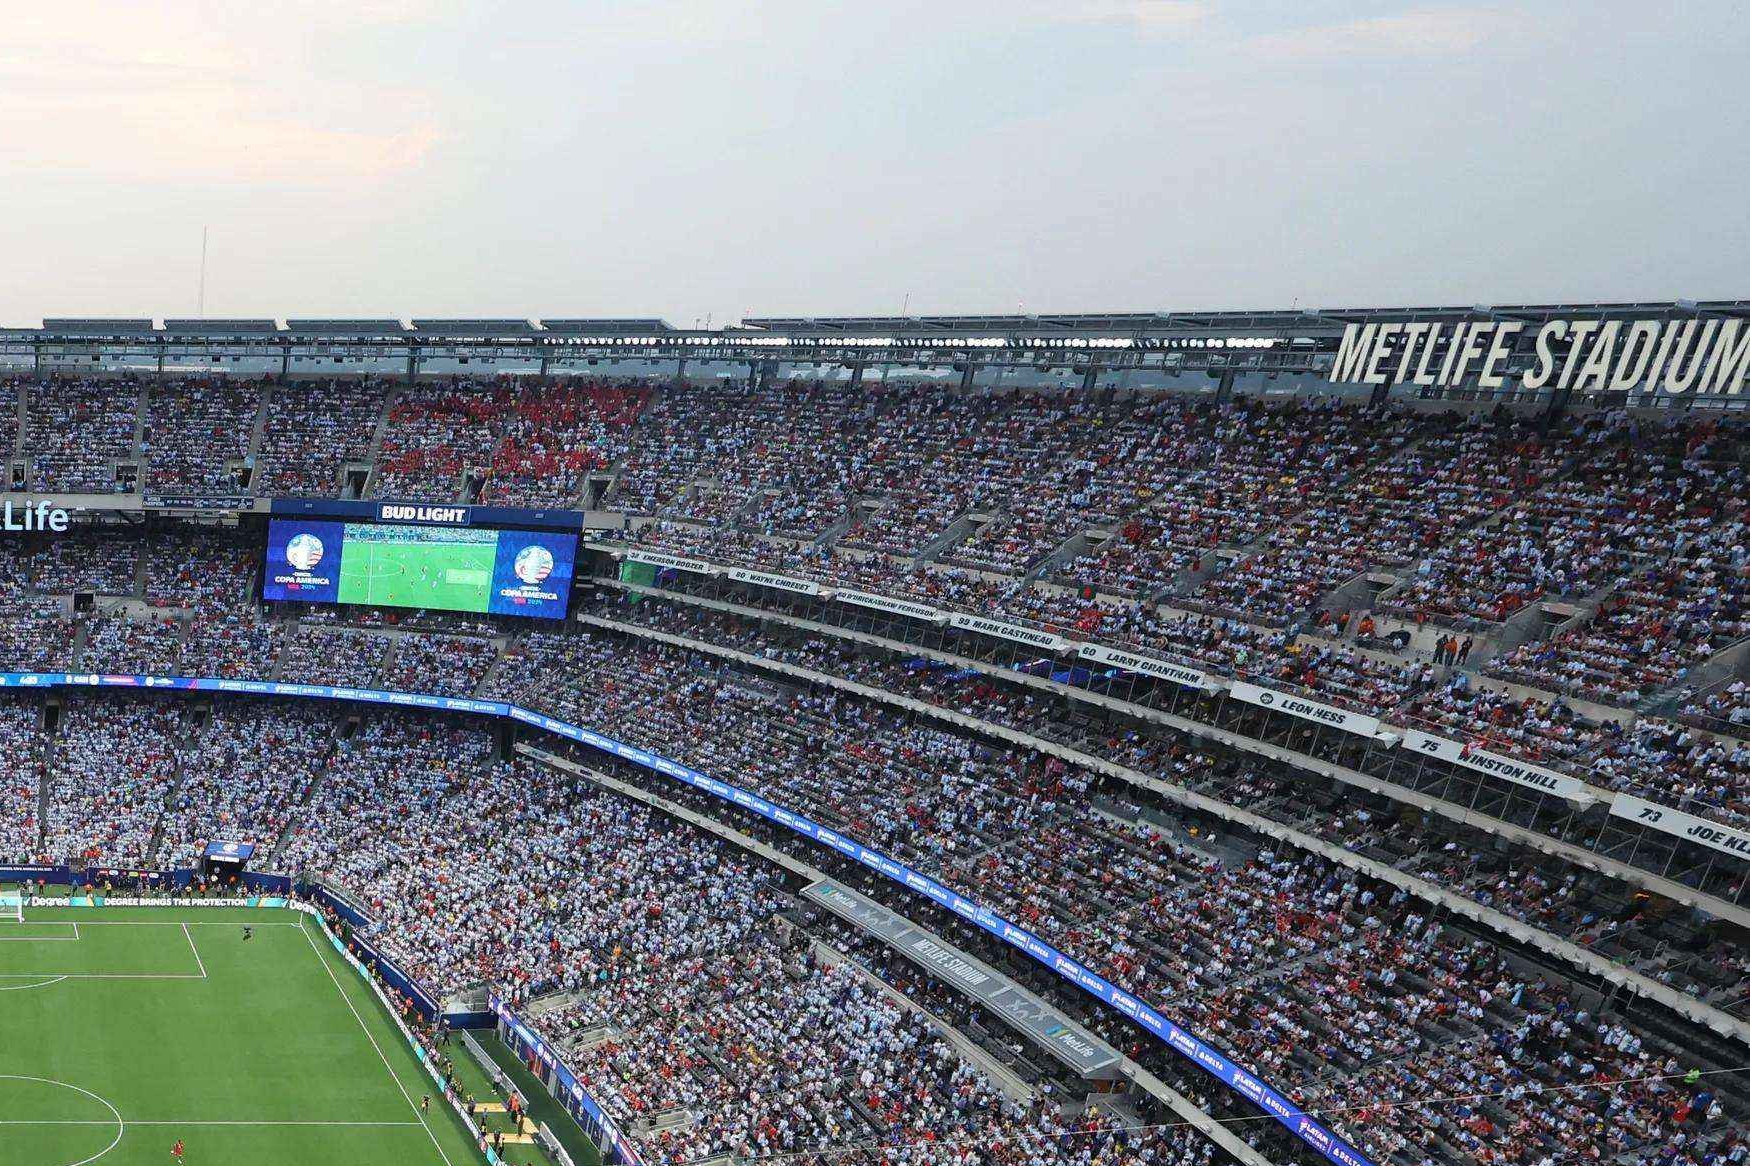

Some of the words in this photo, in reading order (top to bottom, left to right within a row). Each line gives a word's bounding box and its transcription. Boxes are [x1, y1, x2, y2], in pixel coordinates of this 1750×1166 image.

[1330, 321, 1524, 387] METLIFE
[1523, 319, 1750, 395] STADIUM
[382, 505, 416, 520] BUD
[417, 507, 466, 522] LIGHT
[972, 620, 1000, 634] MARK
[1280, 699, 1312, 716] LEON
[1314, 707, 1346, 724] HESS
[1420, 739, 1441, 751] 75
[1458, 751, 1525, 780] WINSTON
[1523, 769, 1558, 790] HILL
[1637, 808, 1662, 822] 73
[1687, 823, 1725, 846] JOE
[31, 896, 69, 907] Degree
[104, 898, 137, 907] DEGREE
[139, 898, 171, 907] BRINGS
[173, 898, 191, 907] THE
[192, 898, 248, 907] PROTECTION
[910, 938, 949, 963] METLIFE
[945, 957, 990, 985] STADIUM
[1060, 1033, 1095, 1058] MetLife
[1241, 1075, 1262, 1094] LATAM
[1271, 1099, 1290, 1118] DELTA
[1307, 1124, 1329, 1144] LATAM
